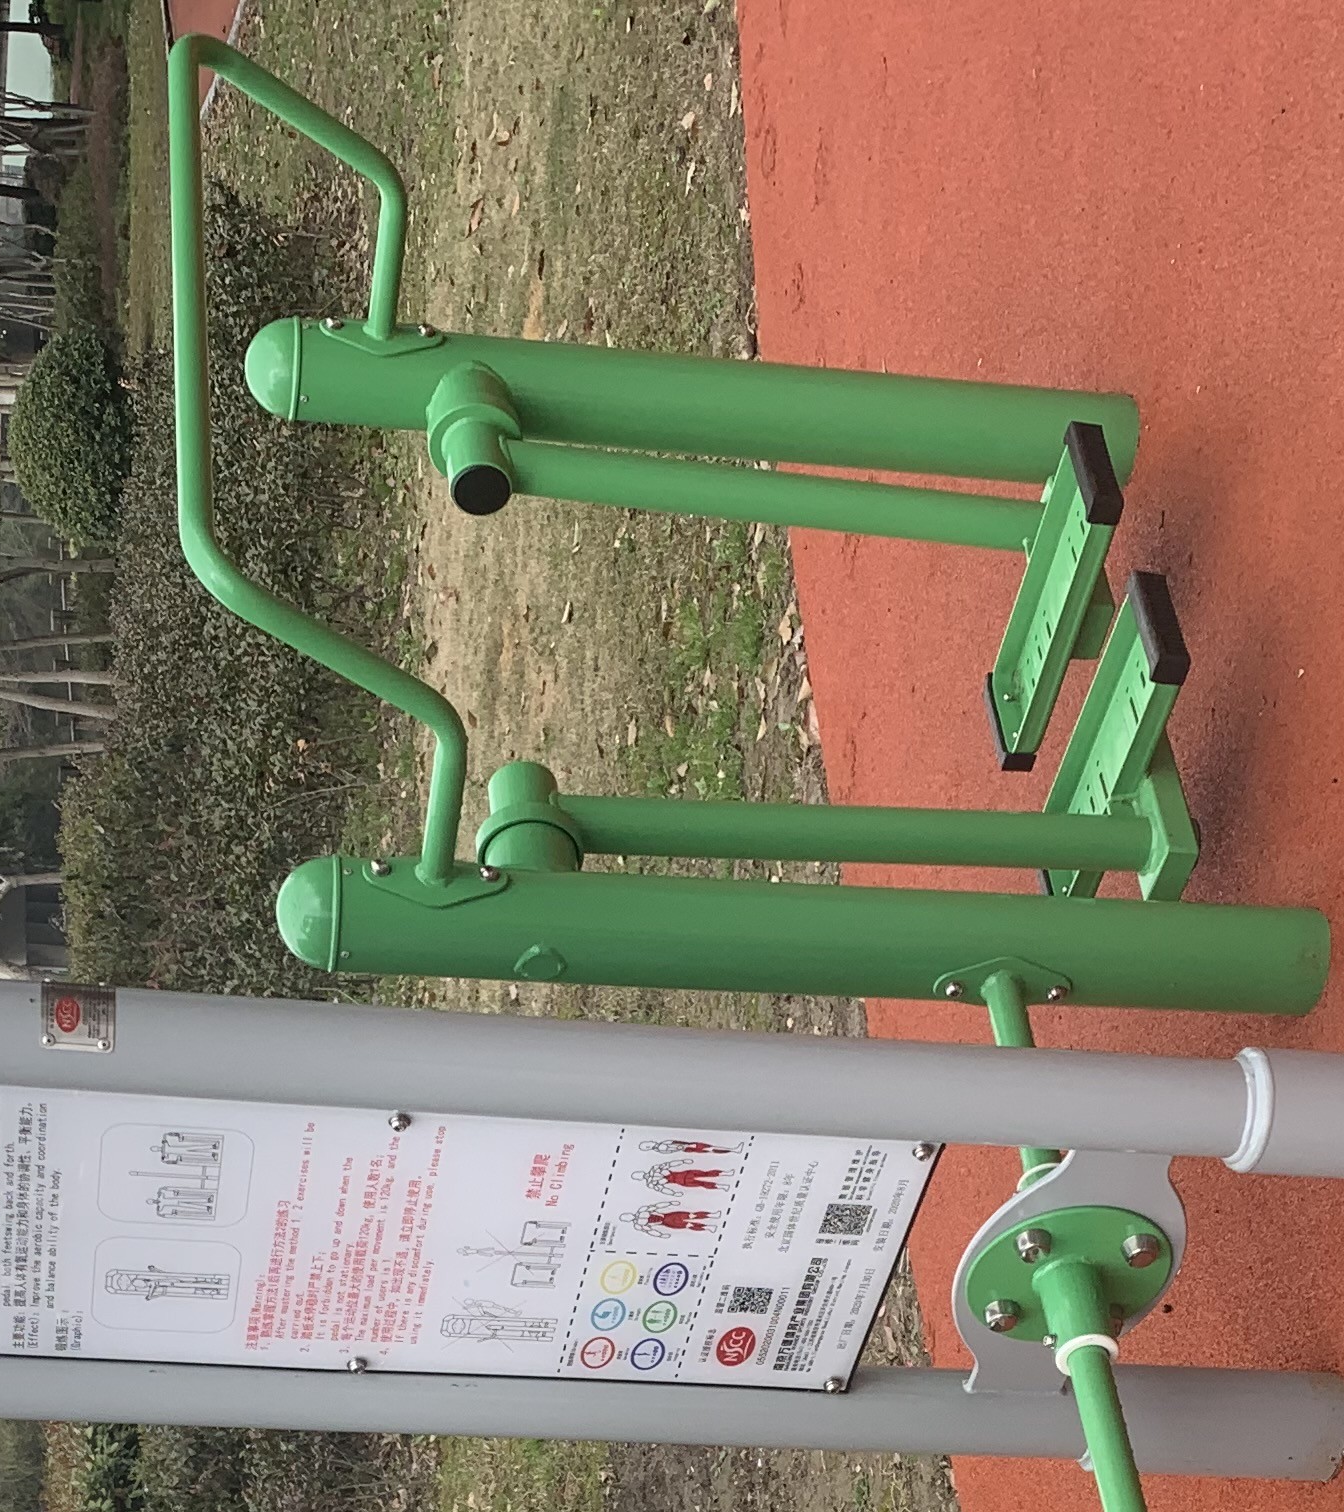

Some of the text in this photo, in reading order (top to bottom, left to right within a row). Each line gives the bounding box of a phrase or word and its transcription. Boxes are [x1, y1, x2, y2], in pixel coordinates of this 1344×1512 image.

[35, 1102, 48, 1160] coordination
[433, 1125, 447, 1144] stop
[300, 1137, 313, 1155] will
[388, 1136, 400, 1150] the
[34, 1164, 45, 1178] and
[341, 1156, 353, 1171] the
[384, 1154, 397, 1168] and
[426, 1148, 443, 1176] please
[549, 1143, 574, 1189] Climbing
[2, 1171, 14, 1186] and
[294, 1159, 310, 1201] exercises
[338, 1175, 350, 1194] when
[524, 1154, 550, 1199] 禁止攀爬
[2, 1190, 13, 1209] back
[33, 1183, 47, 1220] capacity
[48, 1193, 59, 1206] the
[334, 1198, 347, 1216] down
[331, 1220, 343, 1234] and
[416, 1203, 432, 1230] during
[1, 1213, 14, 1254] feetswing
[31, 1224, 43, 1256] aerobic
[46, 1225, 59, 1256] ability
[286, 1227, 300, 1254] method
[370, 1219, 385, 1254] movement
[30, 1260, 41, 1272] the
[284, 1257, 295, 1271] the
[368, 1258, 379, 1271] per
[407, 1234, 424, 1277] discomfort
[0, 1258, 11, 1276] both
[44, 1260, 56, 1291] balance
[28, 1277, 42, 1307] Improve
[363, 1274, 375, 1291] load
[404, 1281, 416, 1294] any
[44, 1295, 54, 1308] and
[278, 1275, 294, 1314] mastering
[318, 1277, 334, 1314] forbidden
[327, 1320, 341, 1341] pedal
[334, 1291, 345, 1303] not
[357, 1295, 371, 1325] maximum
[367, 1317, 381, 1342] number
[376, 1280, 388, 1301] users
[397, 1310, 409, 1330] there
[274, 1318, 287, 1339] After
[288, 1309, 302, 1339] carried
[408, 1323, 421, 1344] using
[354, 1329, 365, 1341] The
[719, 1330, 749, 1361] NSCC
